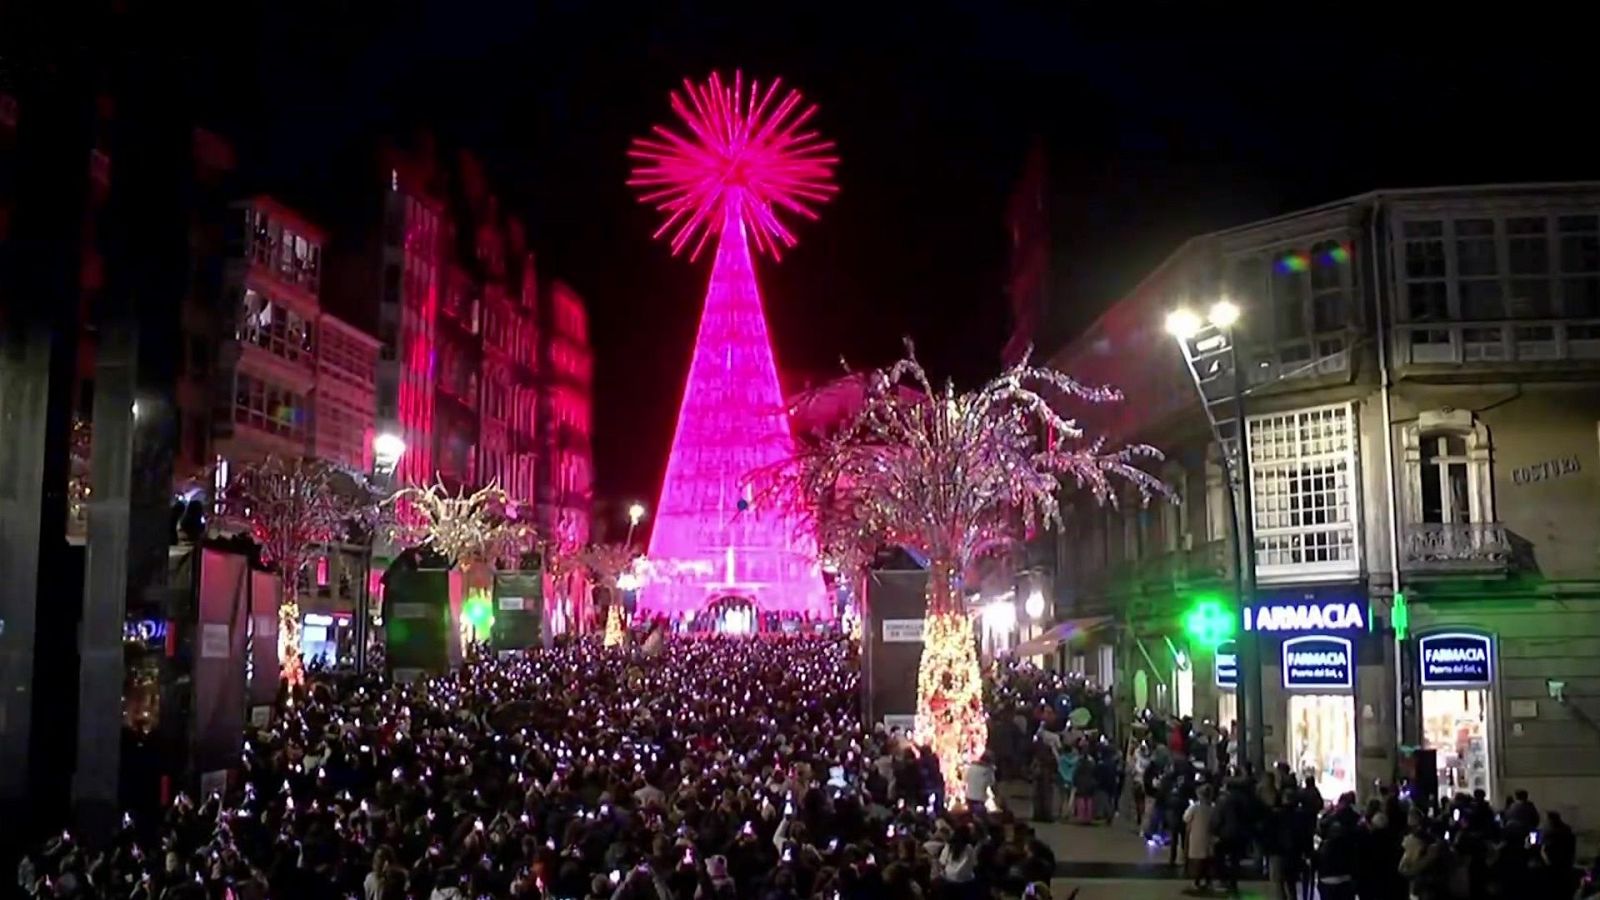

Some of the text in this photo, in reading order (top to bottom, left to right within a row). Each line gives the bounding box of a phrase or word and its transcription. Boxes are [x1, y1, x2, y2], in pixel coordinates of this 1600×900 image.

[1511, 453, 1581, 486] COSTURA
[1288, 651, 1347, 666] FARMACIA
[1425, 648, 1486, 662] FARMACIA
